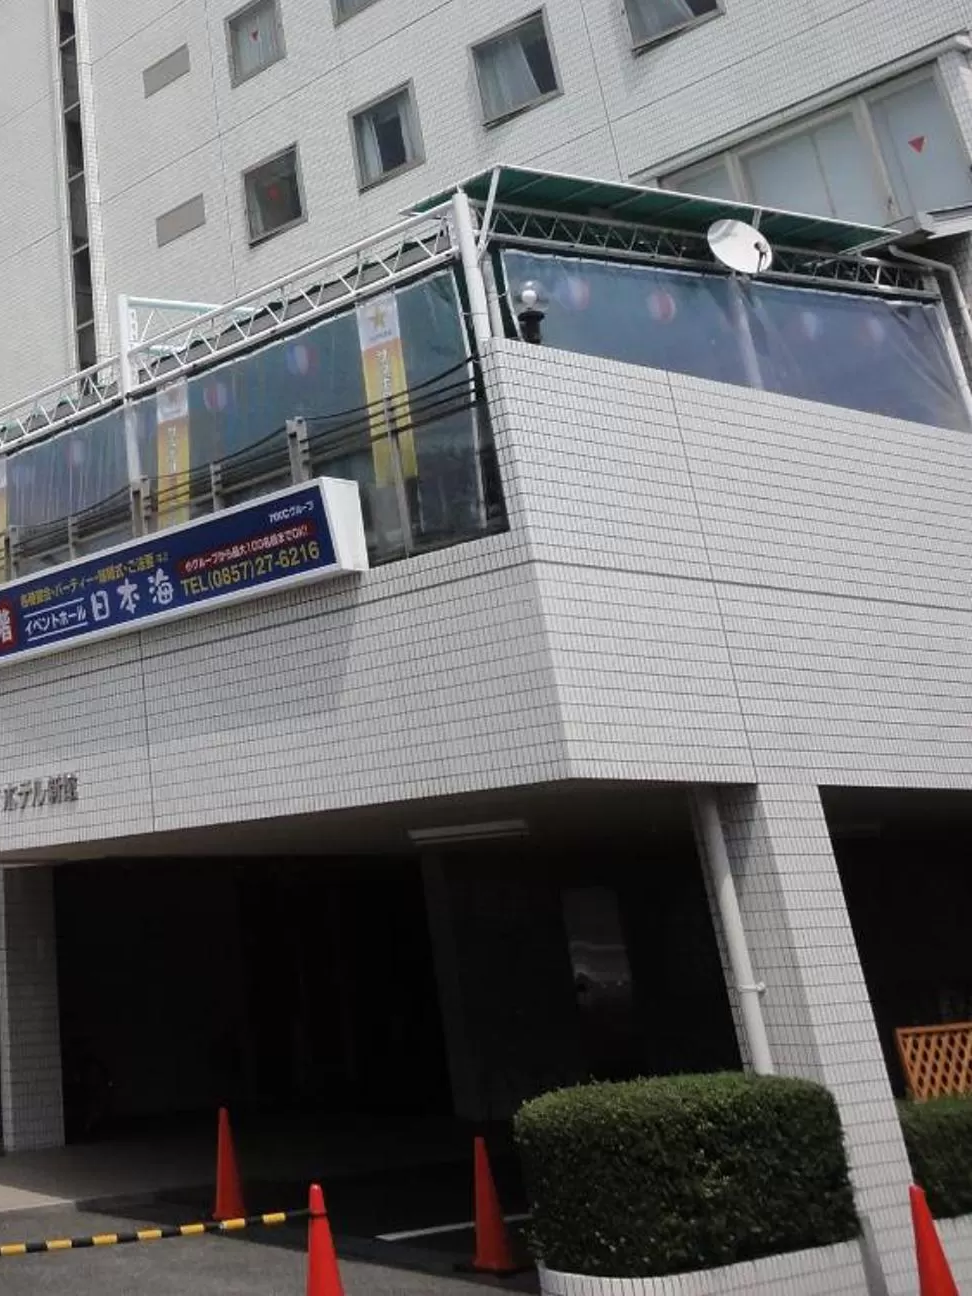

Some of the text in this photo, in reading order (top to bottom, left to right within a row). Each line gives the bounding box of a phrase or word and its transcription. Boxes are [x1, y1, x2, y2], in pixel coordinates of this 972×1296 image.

[24, 567, 175, 636] イベントホール 日本海
